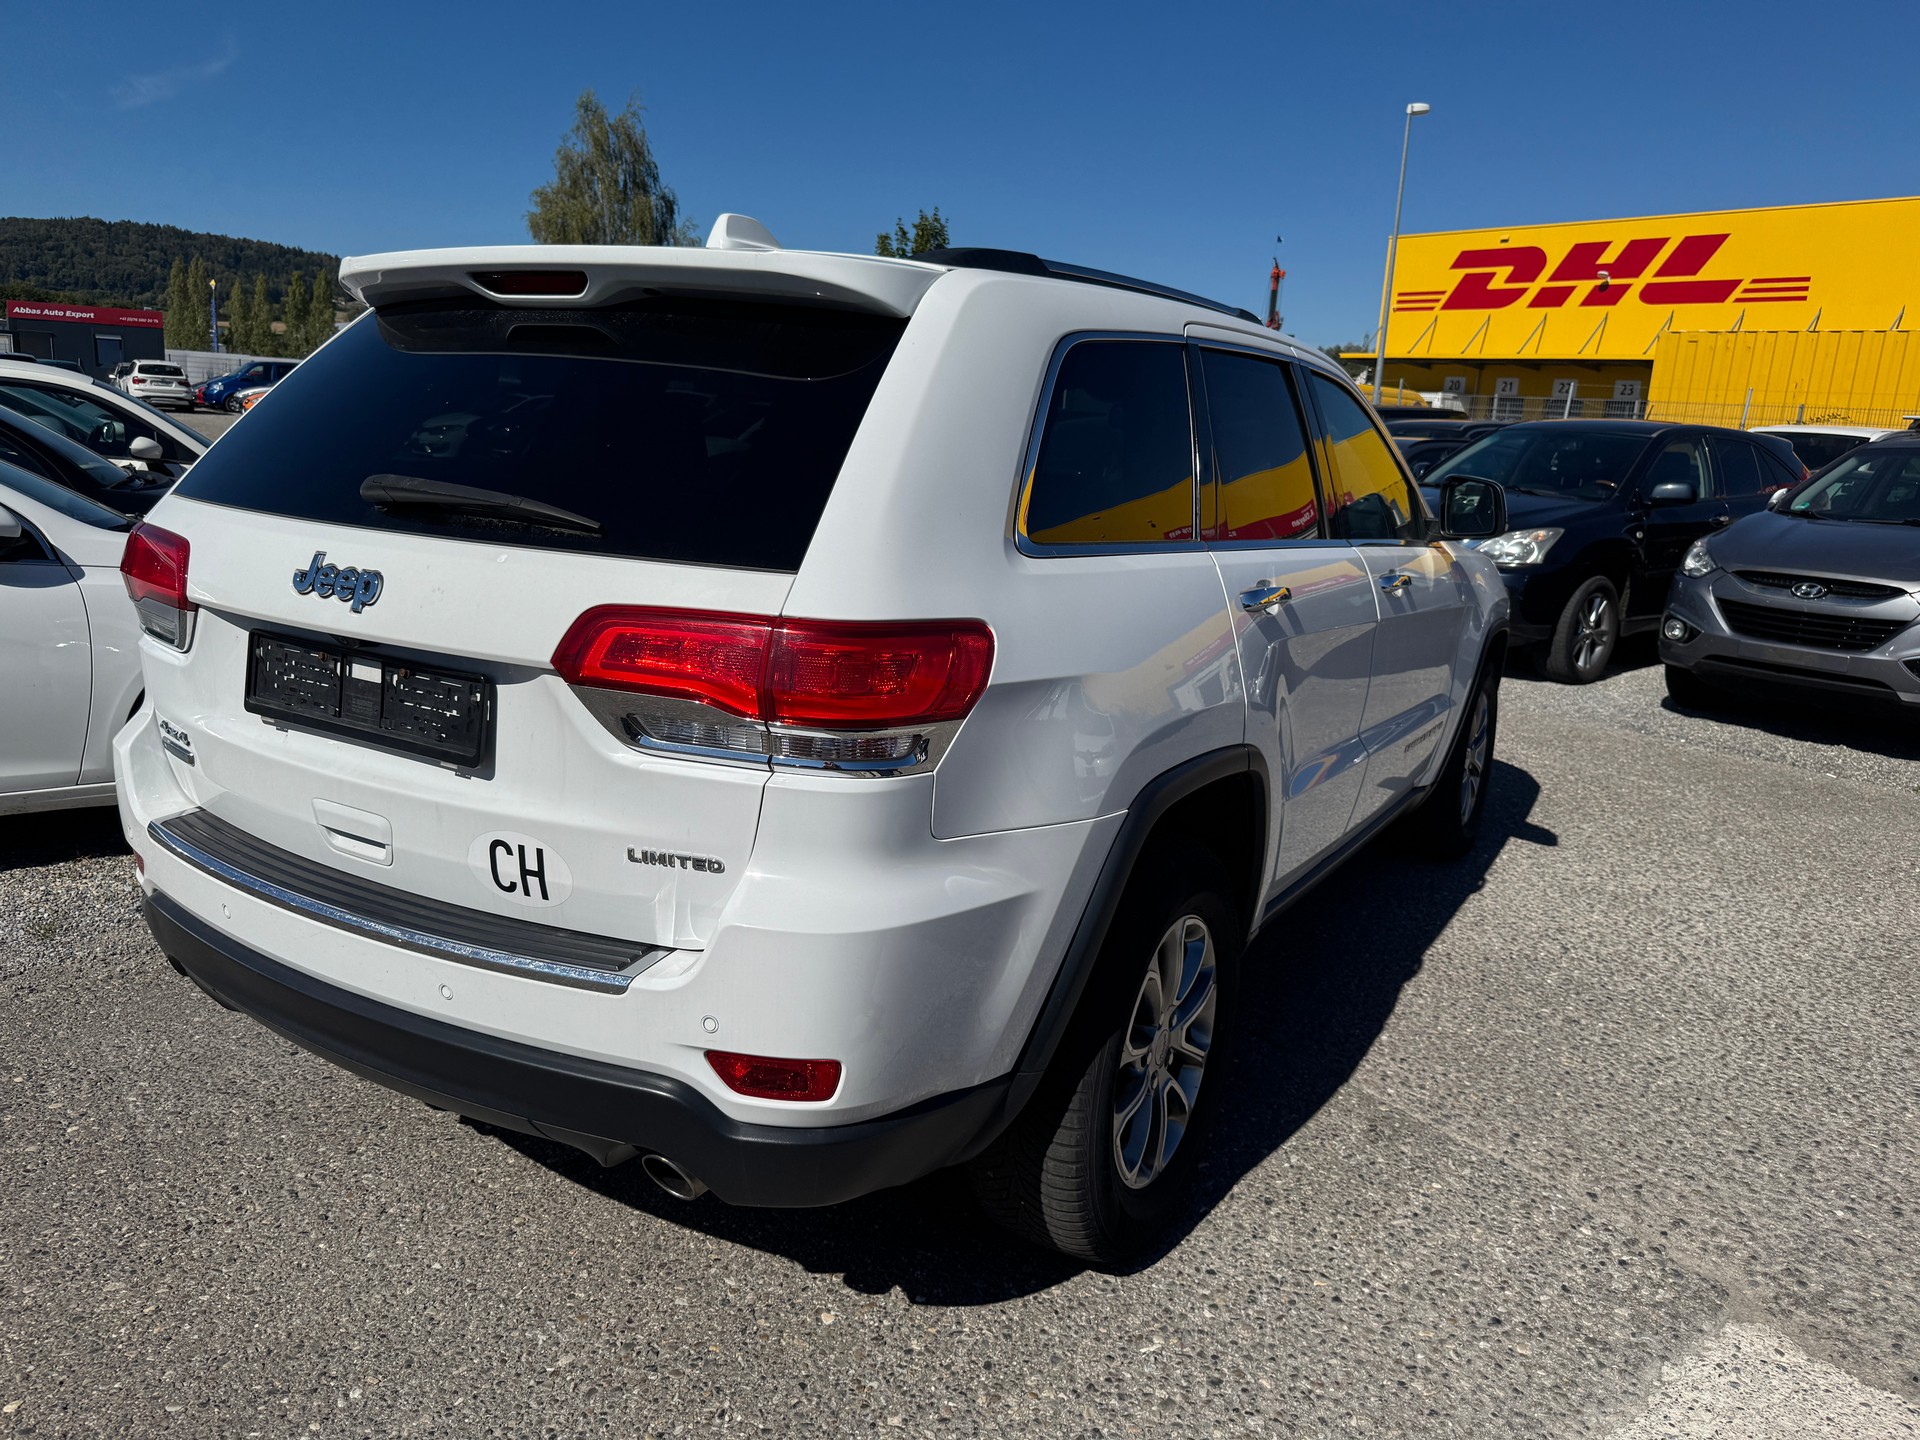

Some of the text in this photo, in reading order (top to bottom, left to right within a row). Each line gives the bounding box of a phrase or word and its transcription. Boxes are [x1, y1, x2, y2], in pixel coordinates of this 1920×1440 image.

[1439, 233, 1744, 310] DHL
[13, 306, 95, 319] Abbas Auto Export
[1448, 380, 1461, 391] 20
[1501, 381, 1513, 392] 21
[1558, 382, 1571, 394] 22
[1620, 384, 1634, 396] 23
[293, 550, 385, 614] Jeep
[626, 845, 726, 874] LIMITED
[489, 839, 550, 901] CH
